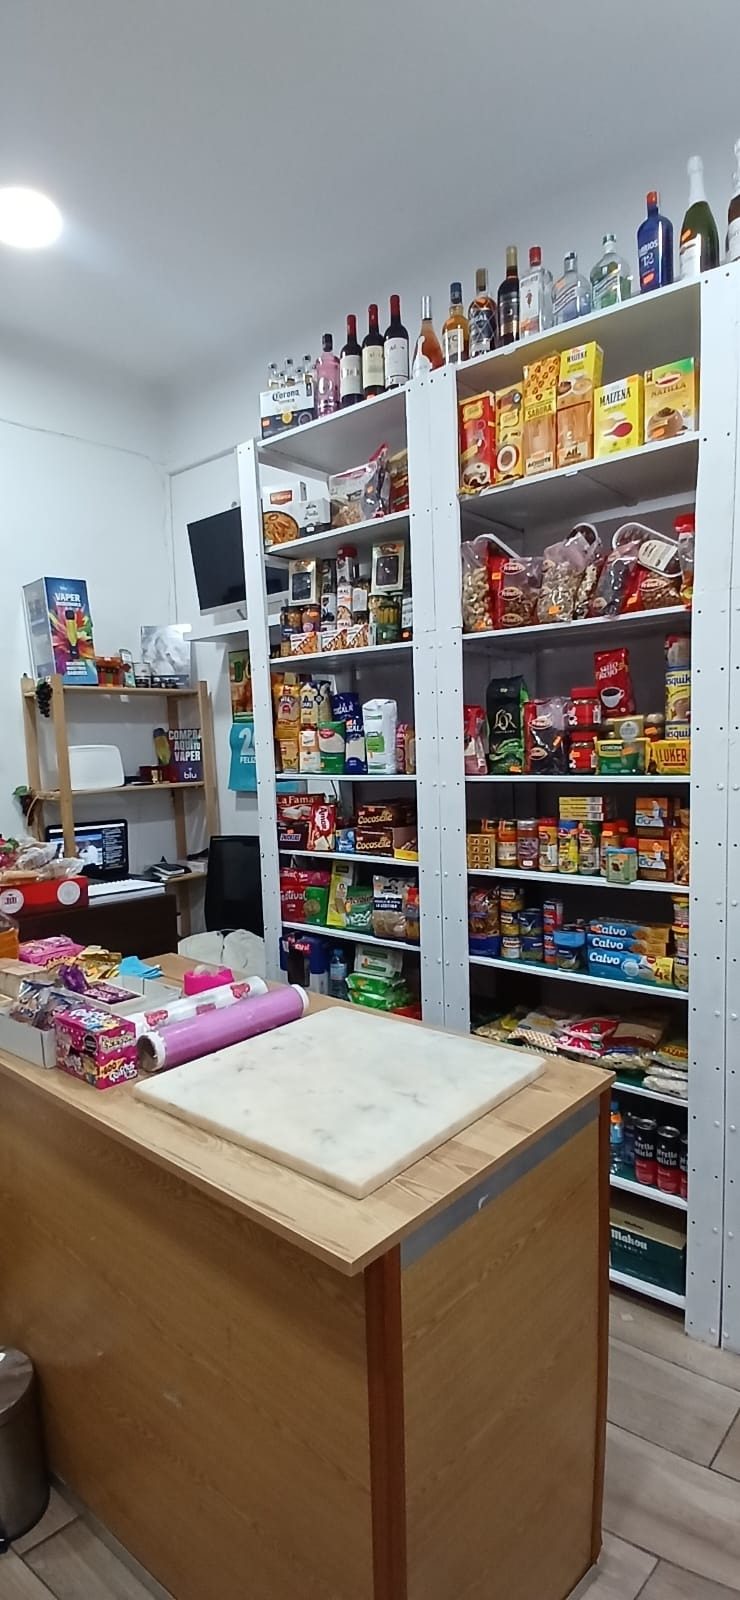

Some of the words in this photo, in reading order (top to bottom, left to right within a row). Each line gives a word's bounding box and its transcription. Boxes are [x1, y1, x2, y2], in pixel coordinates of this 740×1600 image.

[272, 390, 299, 401] Corona
[600, 386, 631, 407] MAIZENA
[55, 592, 81, 602] VAPER
[174, 751, 201, 761] VAPER
[659, 748, 687, 762] LUKER
[184, 768, 197, 779] blu
[288, 795, 314, 805] Fama
[592, 938, 624, 950] Calvo
[589, 953, 620, 965] Calvo
[610, 1228, 648, 1251] Mahou
